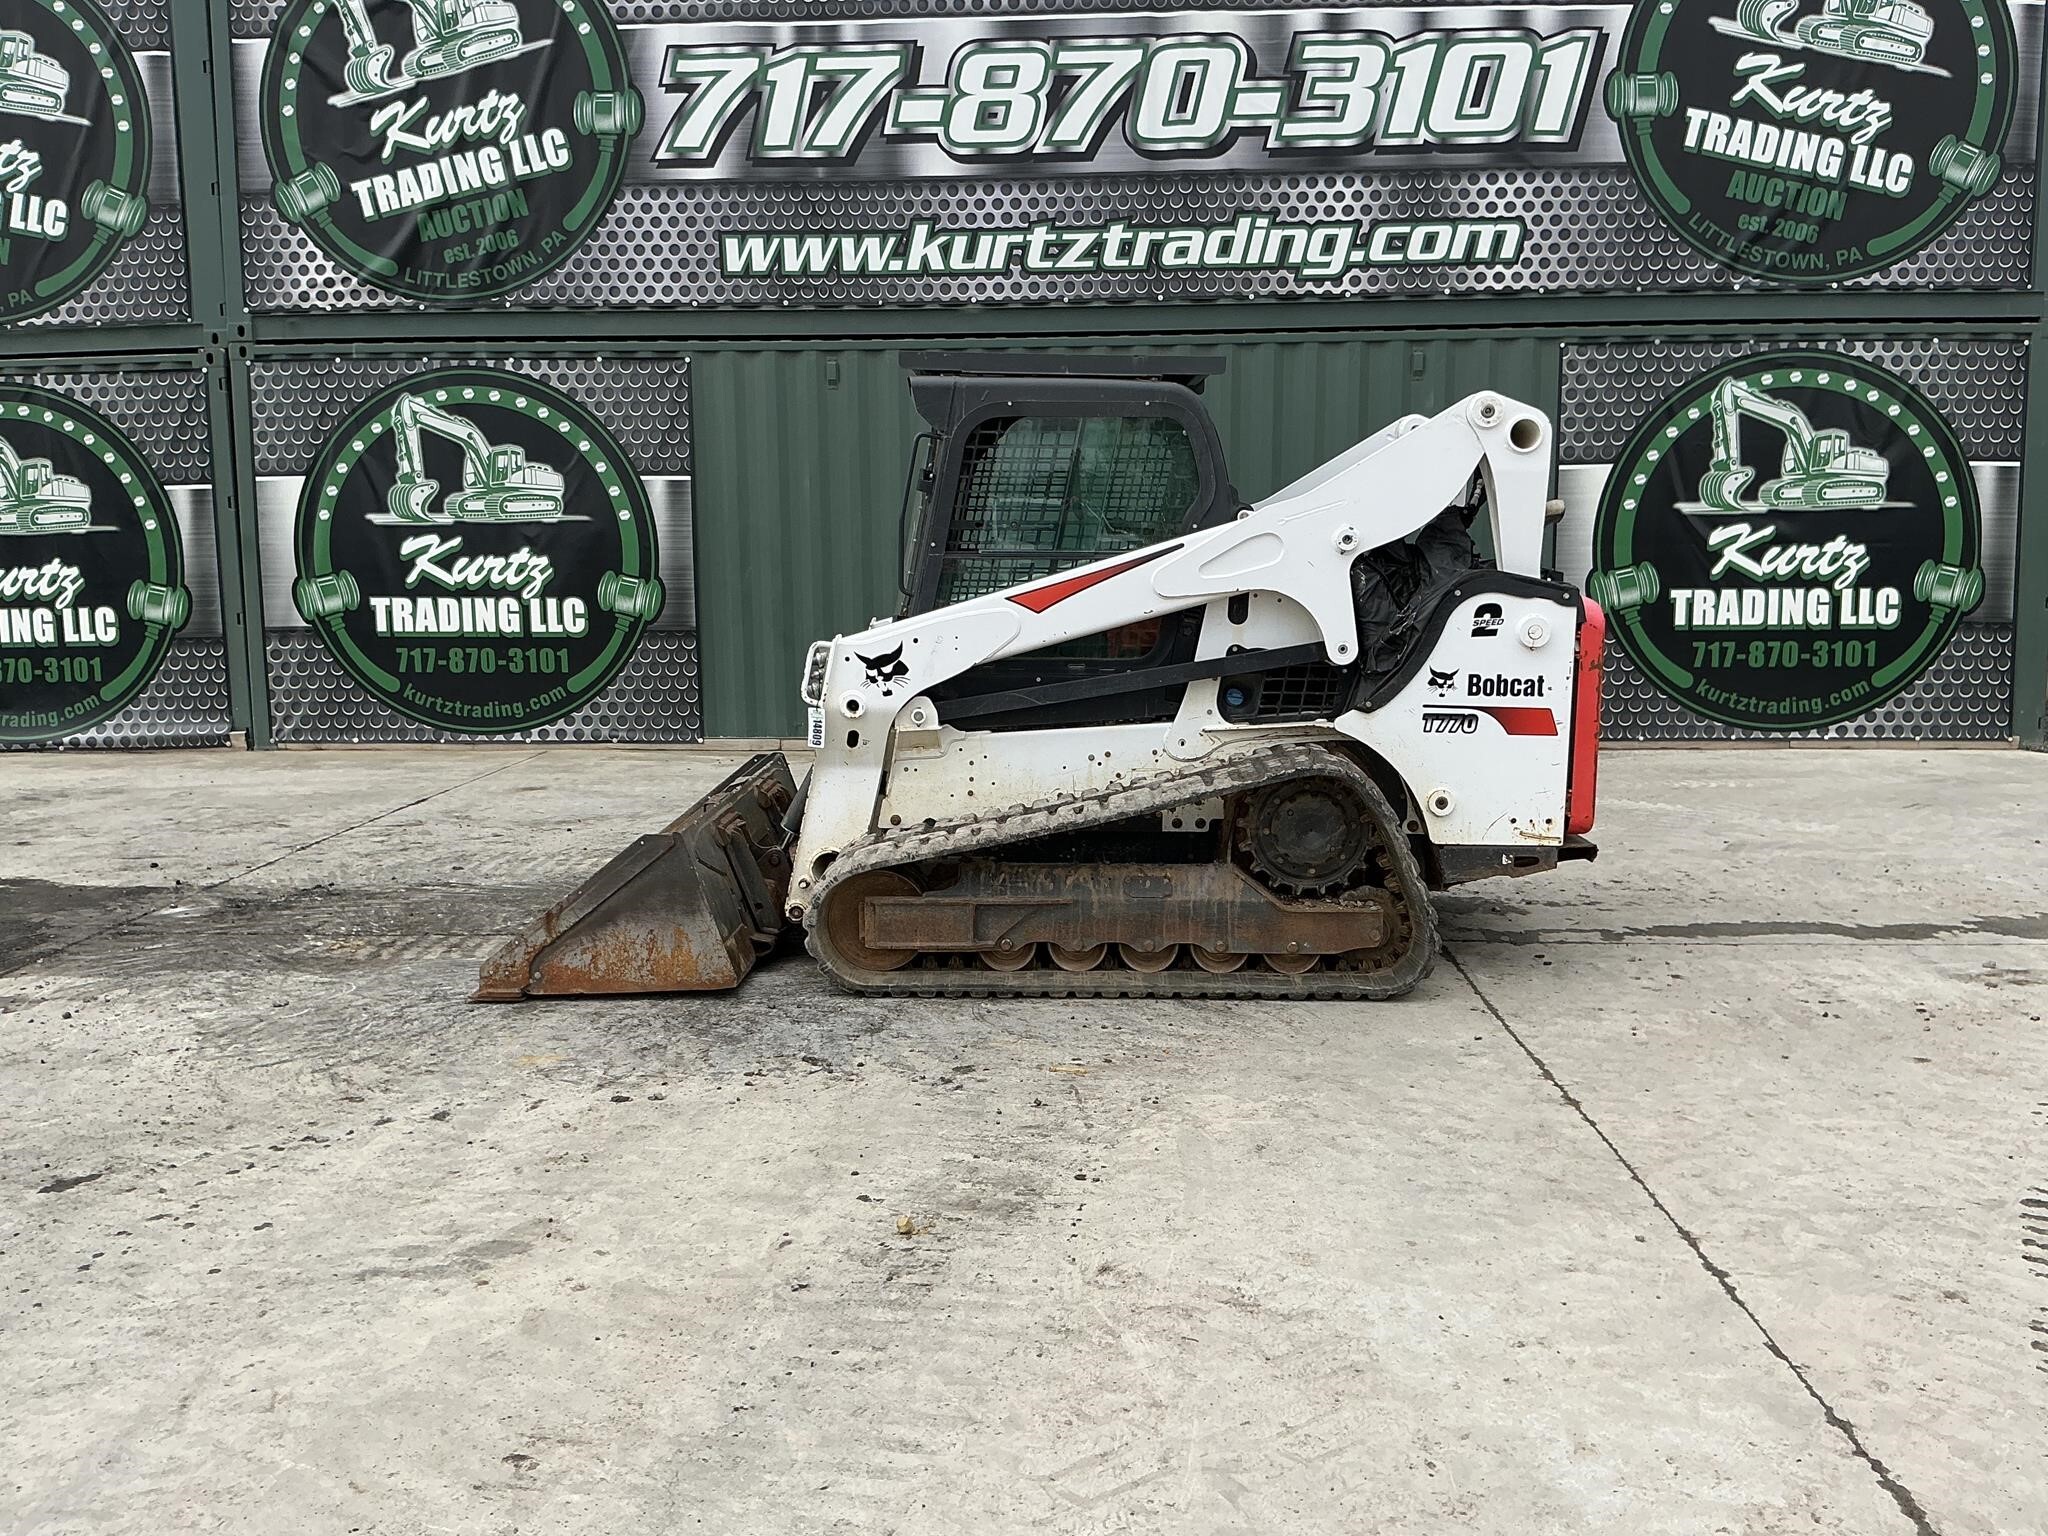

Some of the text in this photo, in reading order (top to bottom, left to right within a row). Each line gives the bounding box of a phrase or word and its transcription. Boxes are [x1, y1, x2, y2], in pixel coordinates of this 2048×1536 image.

[658, 30, 1600, 160] 717-870-3101
[1731, 53, 1893, 146] Kurtz
[370, 89, 527, 164] Kurtz
[1684, 107, 1915, 198] TRADING LLC
[350, 128, 573, 221] TRADING LLC
[1726, 170, 1848, 221] AUCTION
[9, 193, 68, 240] LLC
[417, 188, 529, 242] AUCTION
[1737, 213, 1820, 244] est. 2006
[404, 230, 567, 289] LITTLESTOWN, PA
[443, 228, 519, 264] est. 2006
[720, 213, 1525, 278] www.kurtztrading.com
[1688, 213, 1863, 271] LITTLESTOWN, PA
[7, 289, 33, 308] PA
[400, 534, 555, 602] Kurtz
[1707, 523, 1871, 592] Kurtz
[63, 607, 119, 647] LLC
[369, 596, 589, 638] TRADING LLC
[1471, 603, 1503, 637] 2
[1472, 618, 1504, 627] SPEED
[1670, 587, 1901, 630] TRADING LLC
[396, 647, 569, 674] 717-870-3101
[1692, 640, 1876, 668] 717-870-3101
[403, 683, 567, 719] kurtztrading.com
[1467, 674, 1545, 697] Bobcat
[1696, 678, 1870, 715] kurtztrading.com
[812, 719, 823, 746] 14809
[1422, 713, 1479, 734] T770
